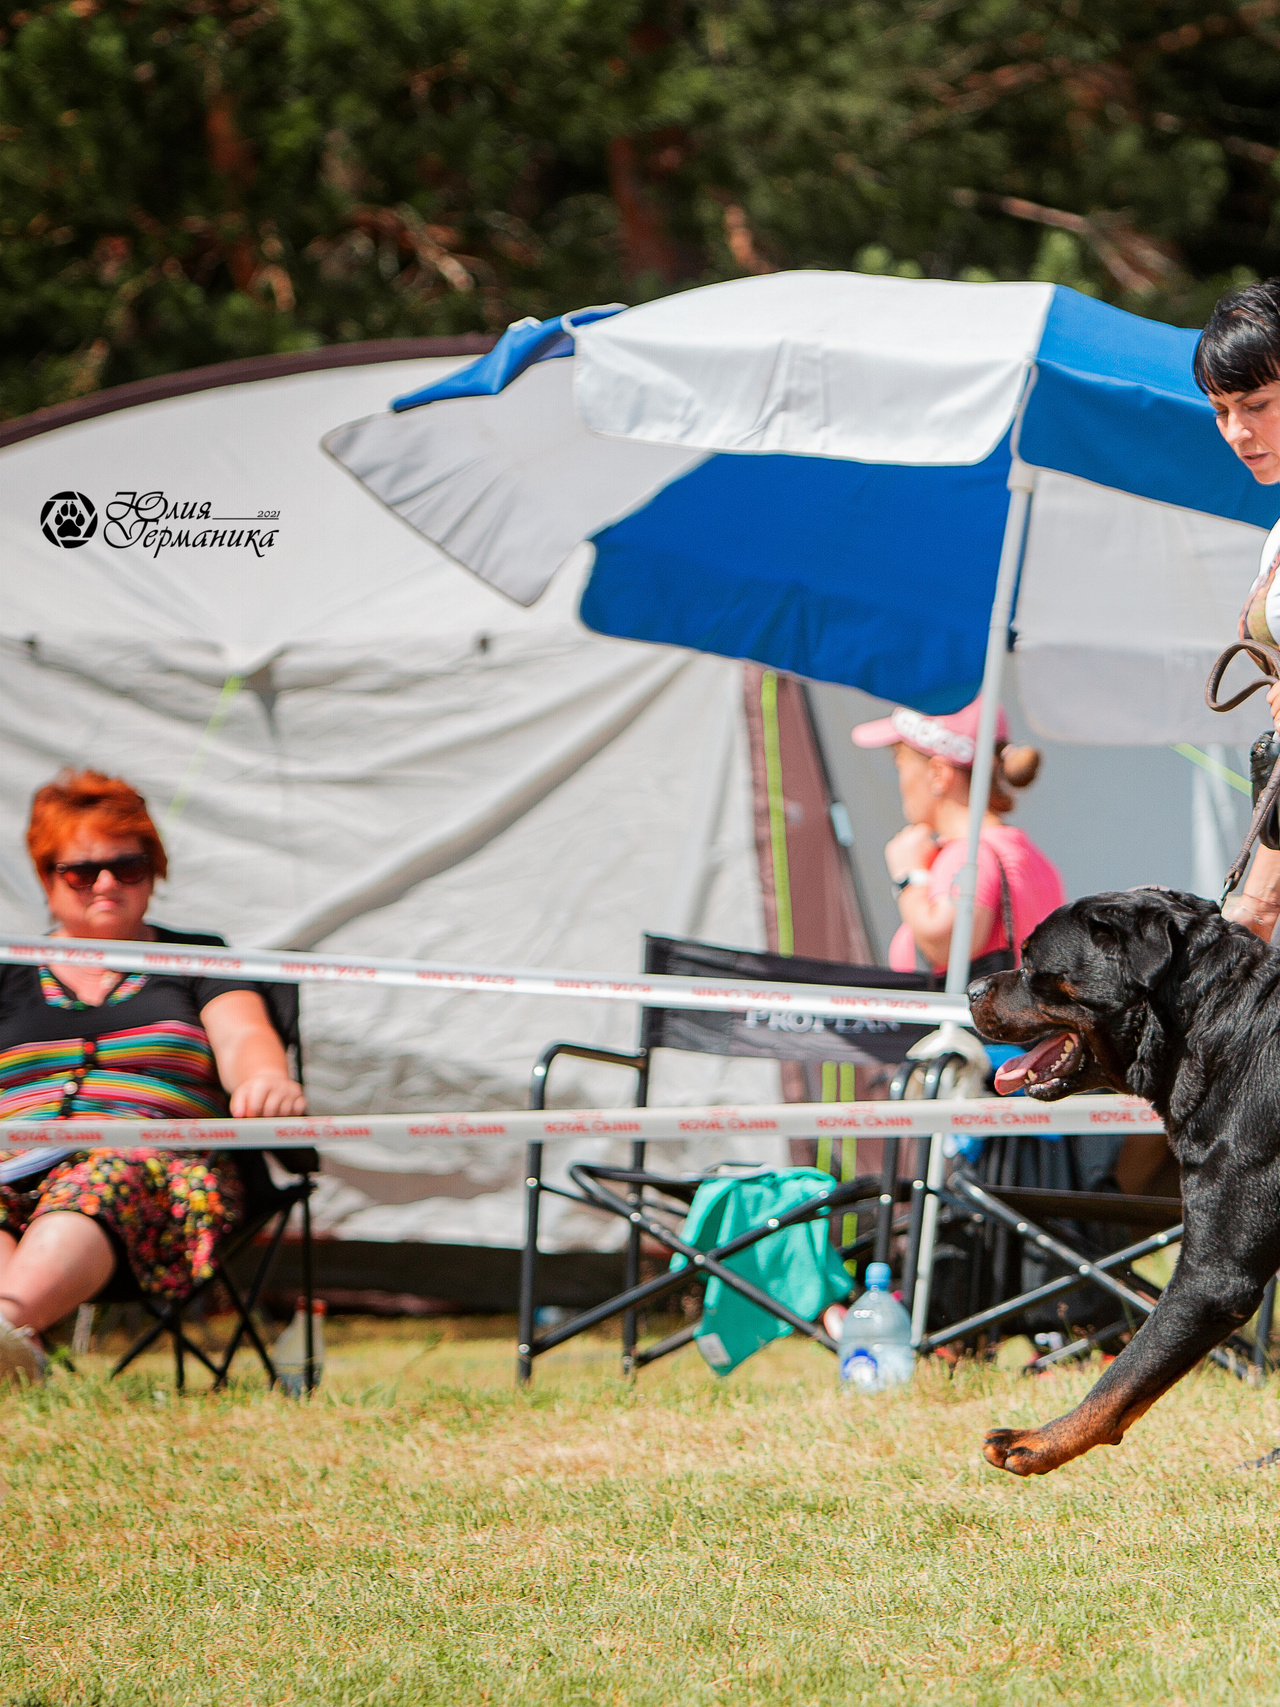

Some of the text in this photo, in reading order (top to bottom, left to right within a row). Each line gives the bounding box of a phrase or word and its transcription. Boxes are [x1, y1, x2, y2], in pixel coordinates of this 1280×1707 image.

[816, 1115, 913, 1128] ROYAL CANIN
[951, 1112, 1051, 1126] ROYAL CANIN
[1089, 1110, 1136, 1123] ROYAL
[544, 1119, 642, 1133] ROYAL CANIN
[678, 1117, 778, 1131] ROYAL CANIN
